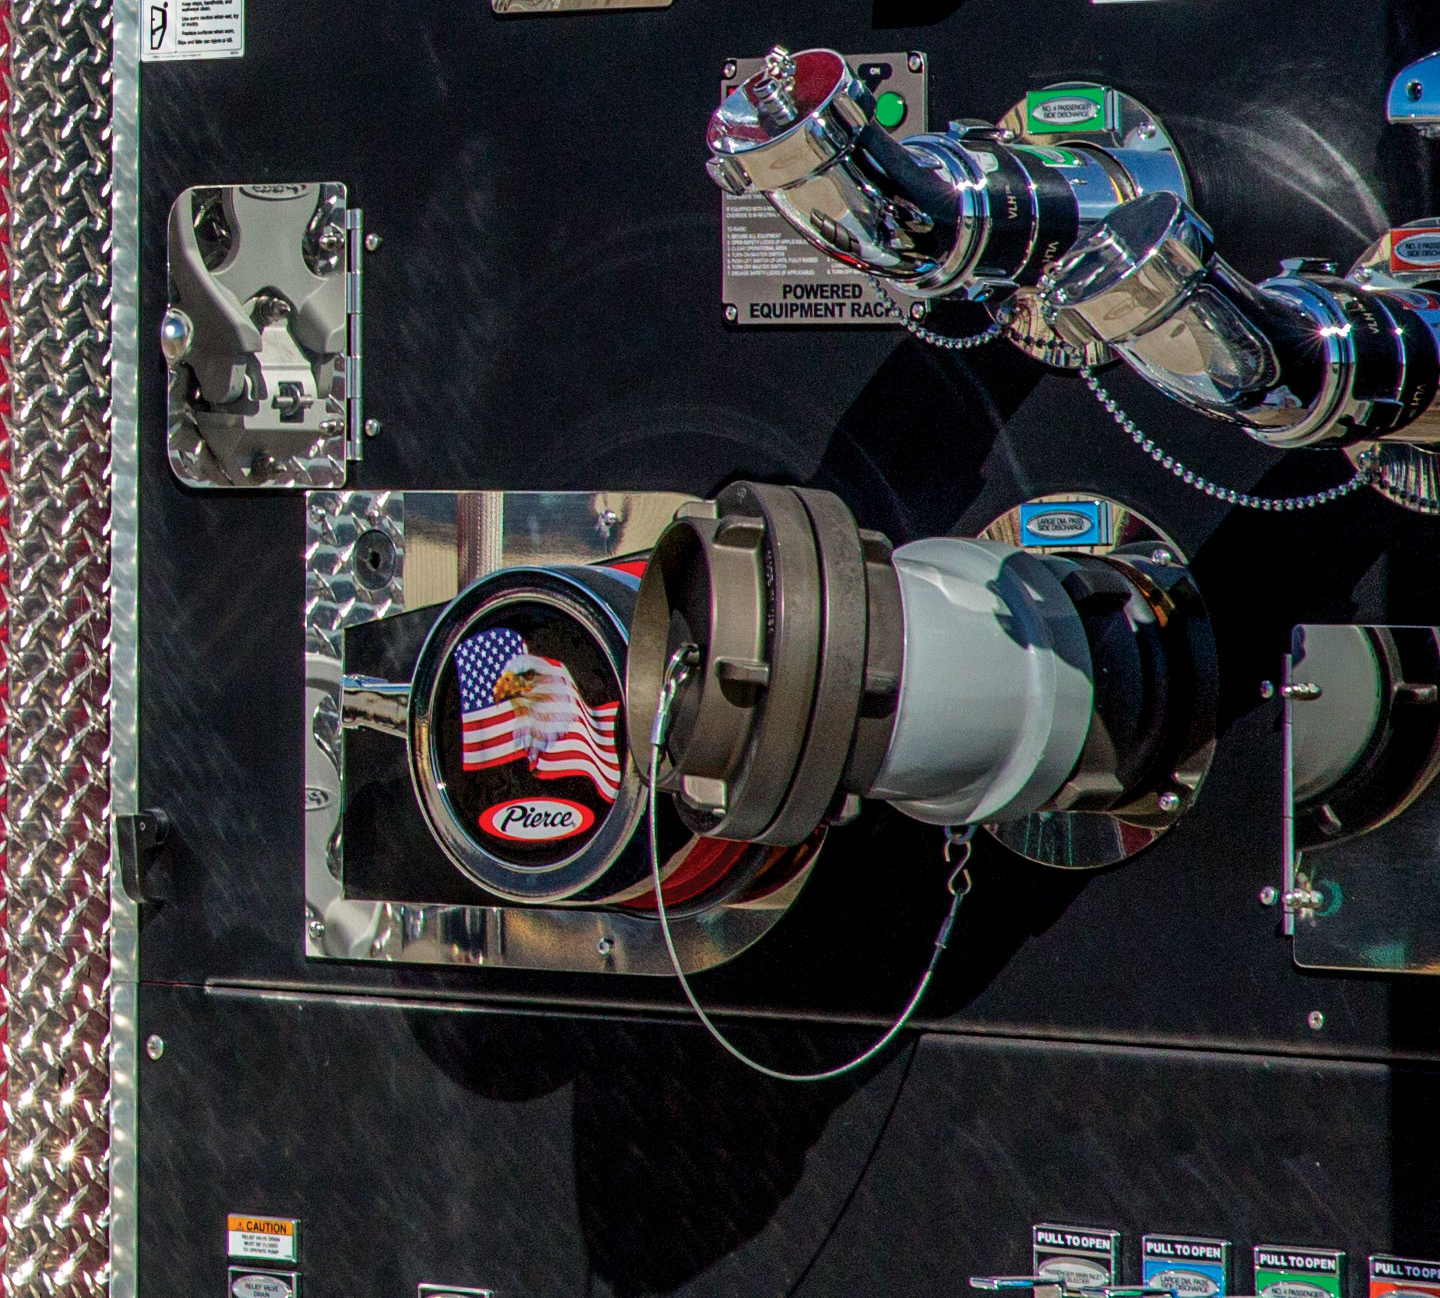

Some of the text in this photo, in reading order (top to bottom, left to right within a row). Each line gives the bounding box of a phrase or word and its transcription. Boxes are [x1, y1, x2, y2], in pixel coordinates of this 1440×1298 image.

[783, 284, 863, 299] POWERED
[750, 303, 847, 319] EQUIPMENT
[500, 805, 574, 833] Pierce
[246, 1221, 287, 1234] CAUTION
[1038, 1231, 1111, 1250] PULL TO OPEN
[1147, 1242, 1221, 1259] PULL TO OPEN
[1260, 1254, 1336, 1270] PULL TO OPEN
[1375, 1262, 1404, 1276] PULL
[1405, 1265, 1420, 1277] TO
